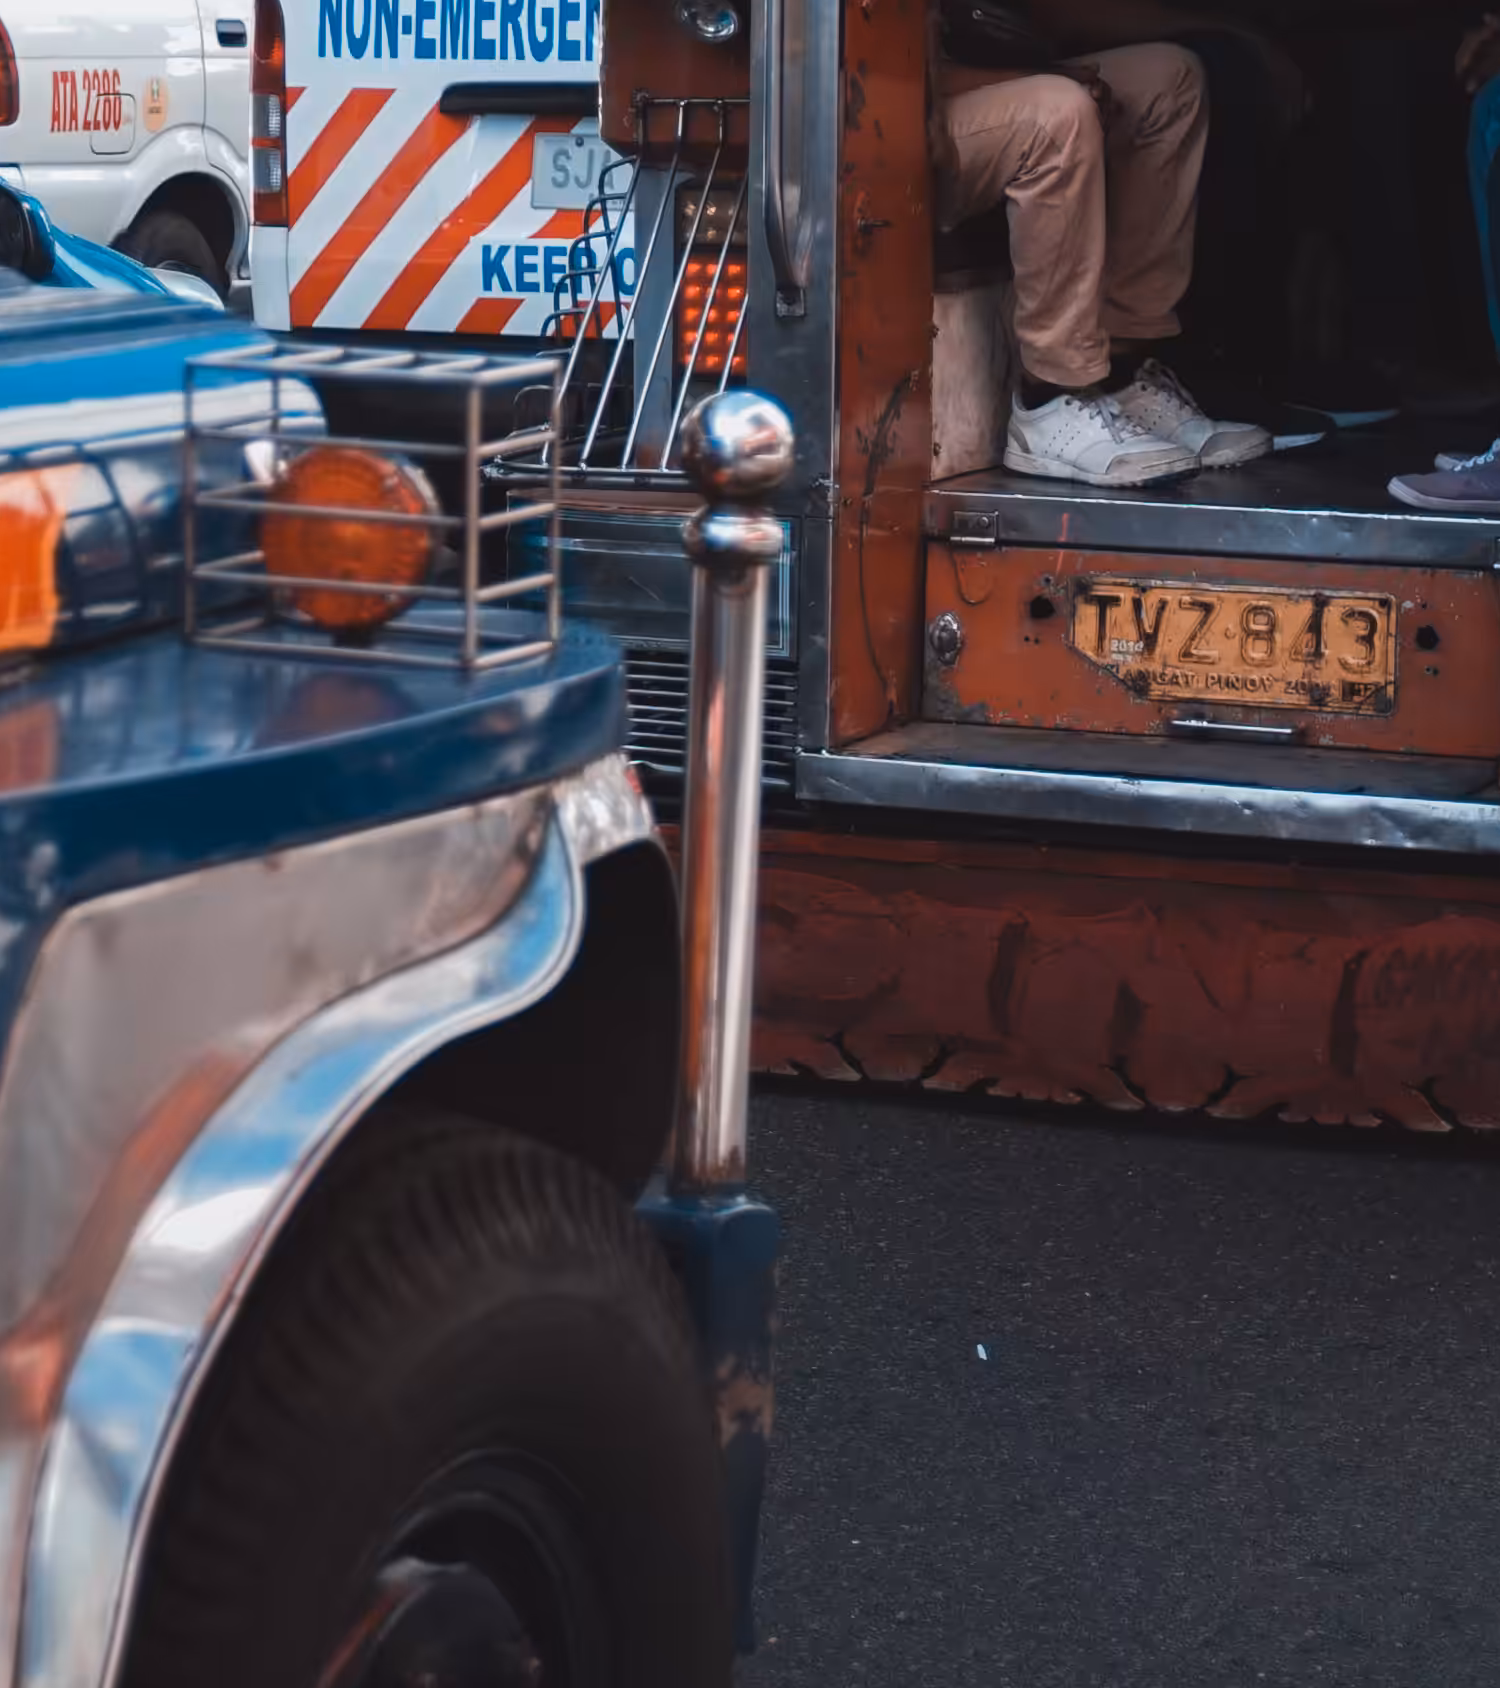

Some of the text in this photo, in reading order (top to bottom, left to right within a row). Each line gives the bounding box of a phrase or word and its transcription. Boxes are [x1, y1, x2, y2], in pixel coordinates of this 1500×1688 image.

[50, 68, 122, 134] ATA 2286
[1088, 592, 1381, 675] TVZ 843
